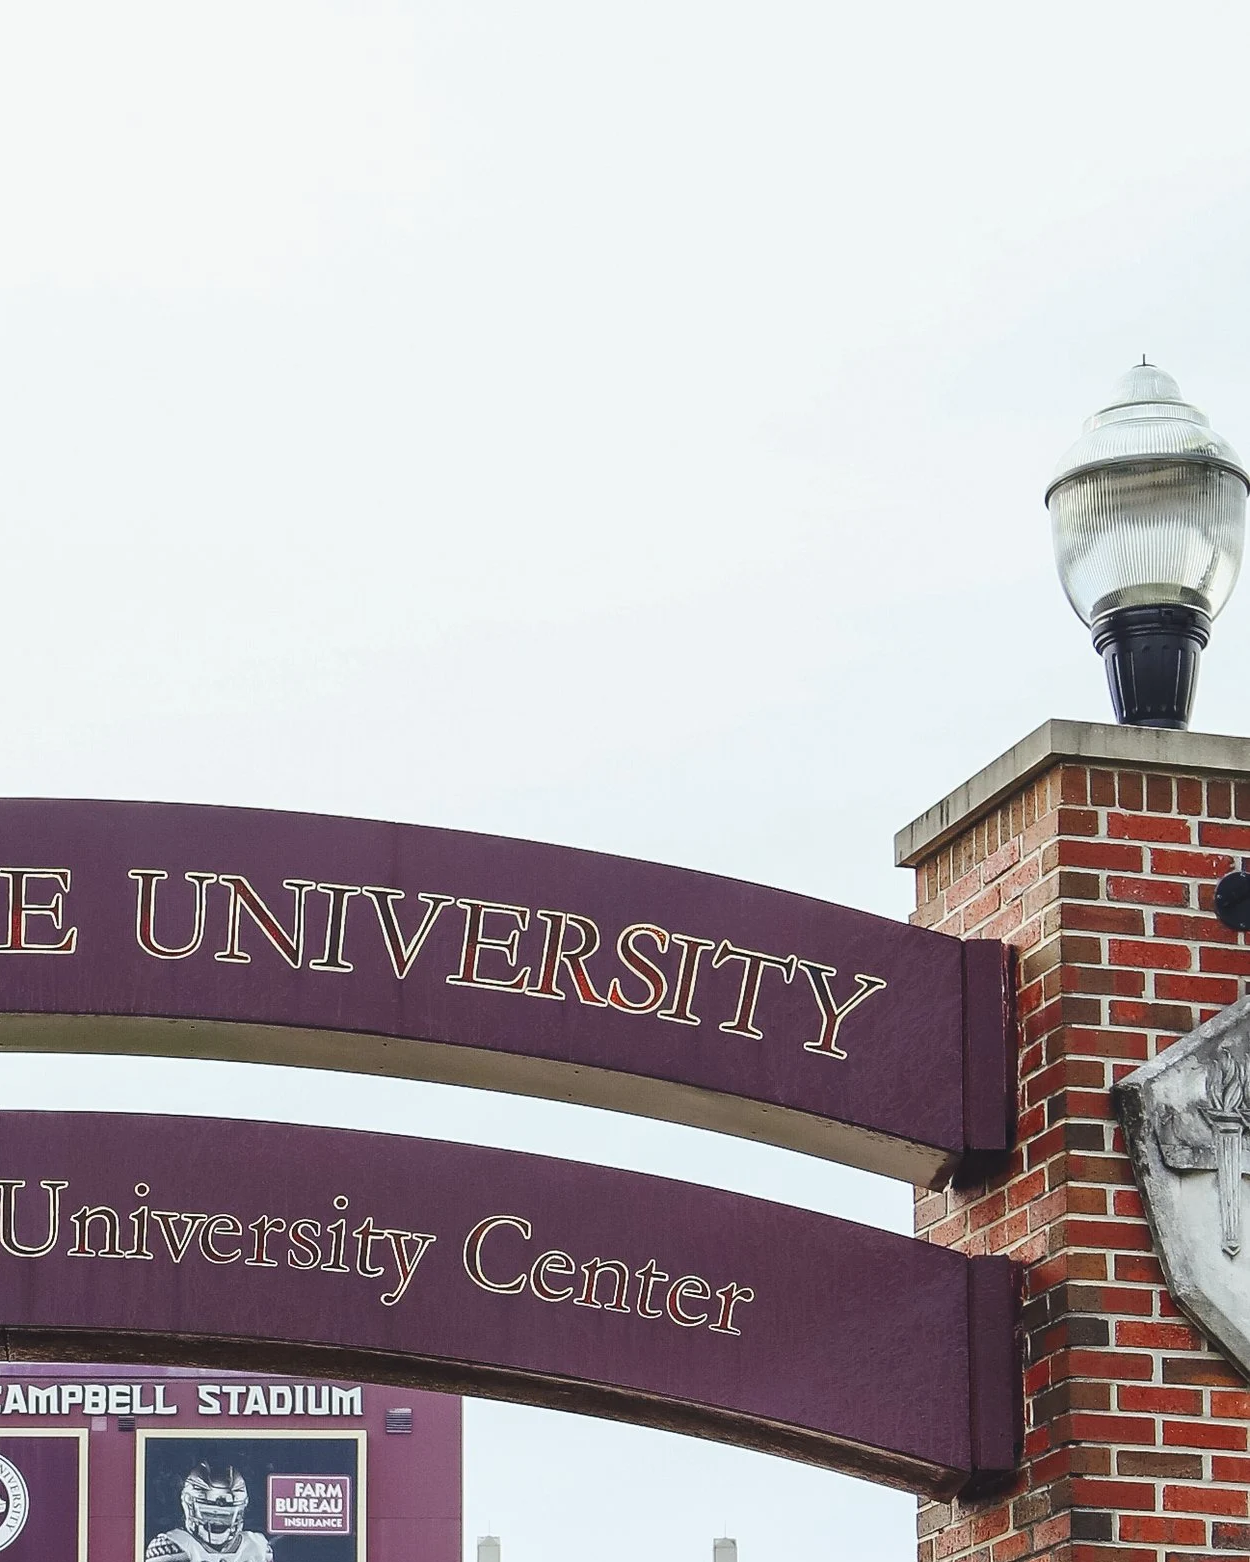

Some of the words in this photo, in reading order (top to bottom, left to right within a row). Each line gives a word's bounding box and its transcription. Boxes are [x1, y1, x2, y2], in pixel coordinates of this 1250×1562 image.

[128, 868, 886, 1060] UNIVERSITY
[463, 1215, 755, 1336] Center
[197, 1384, 364, 1416] STADIUM
[295, 1482, 343, 1498] FARM
[275, 1498, 343, 1513] BUREAU
[284, 1517, 343, 1528] INSURANCE
